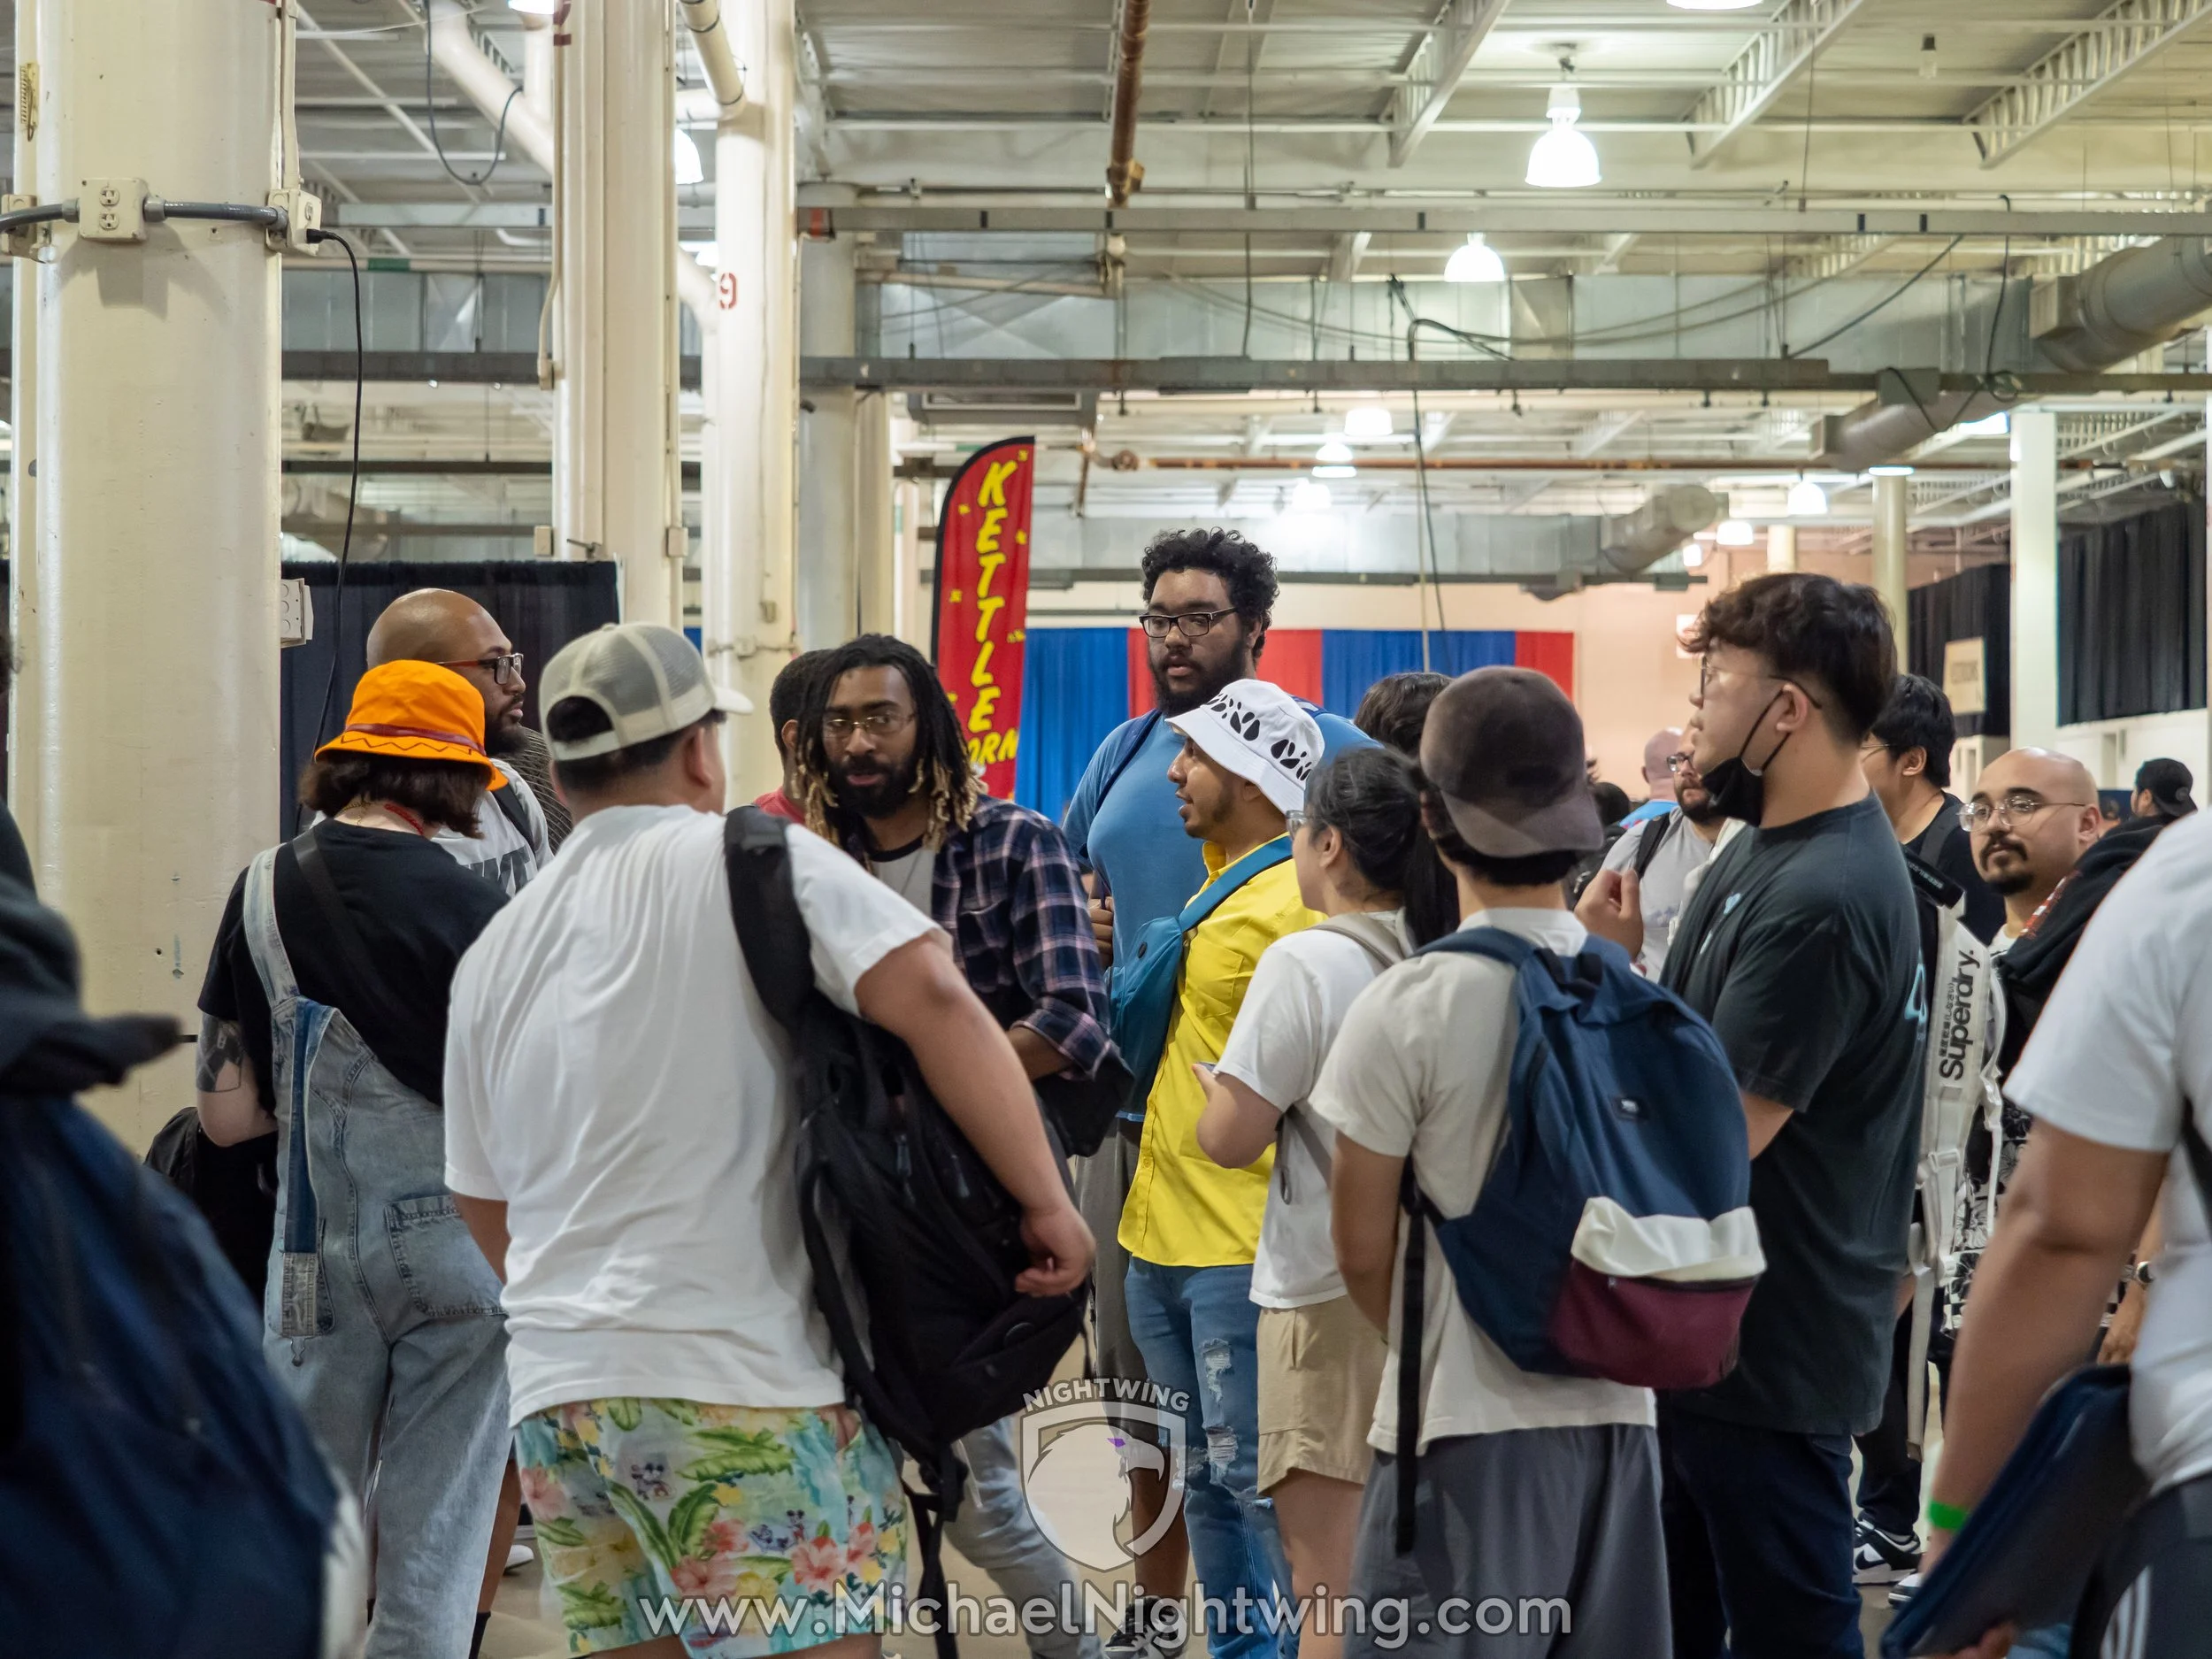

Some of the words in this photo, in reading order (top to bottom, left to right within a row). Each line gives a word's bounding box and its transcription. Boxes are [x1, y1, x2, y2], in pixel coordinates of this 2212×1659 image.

[719, 272, 737, 311] 9
[968, 459, 1018, 733] KETTLE
[968, 727, 1018, 765] ORN
[1938, 949, 1980, 1080] Superdry.
